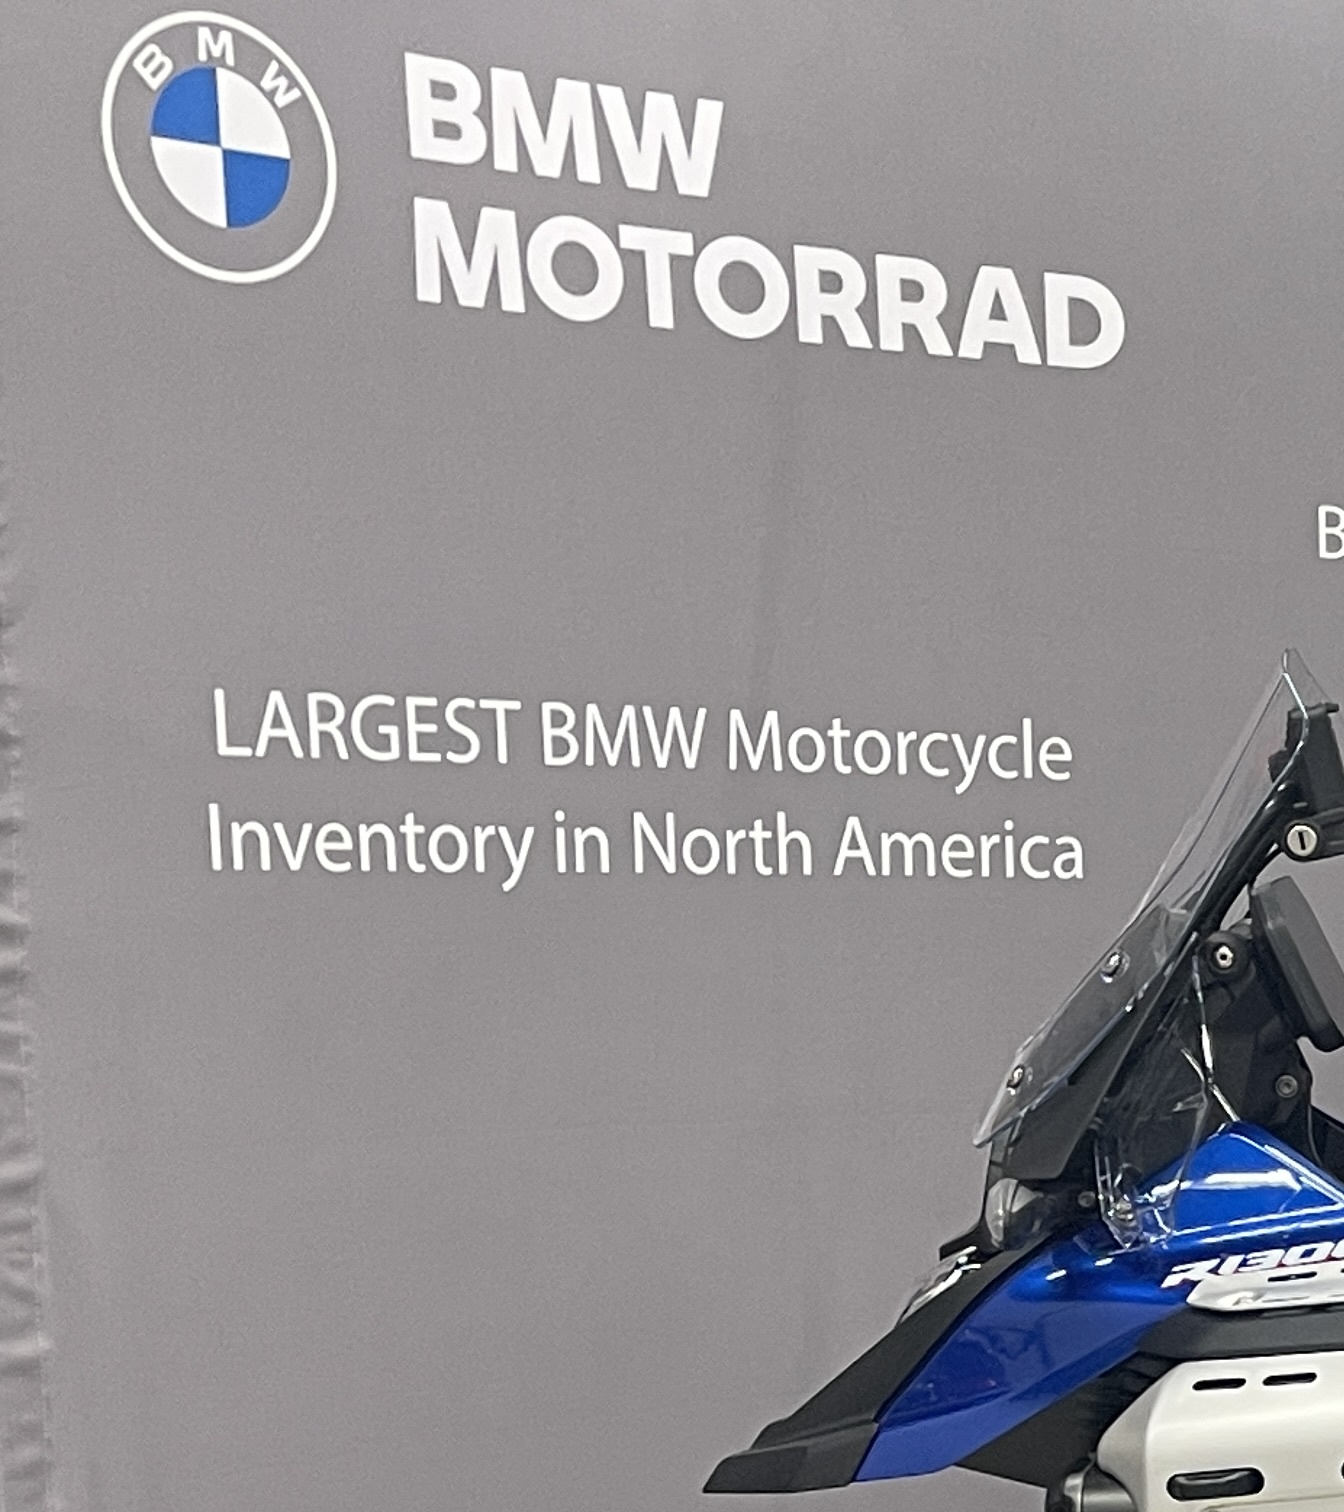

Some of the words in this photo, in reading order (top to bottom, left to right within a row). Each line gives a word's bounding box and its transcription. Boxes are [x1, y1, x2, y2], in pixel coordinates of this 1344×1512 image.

[132, 26, 302, 109] BMW
[405, 52, 724, 198] BMW
[413, 197, 1125, 369] MOTORRAD
[213, 687, 522, 764] LARGEST
[541, 701, 707, 770] BMW
[728, 708, 1073, 795] Motorcycle
[208, 803, 535, 892] Inventory
[554, 809, 610, 874] in
[633, 810, 812, 876] North
[833, 815, 1084, 880] America
